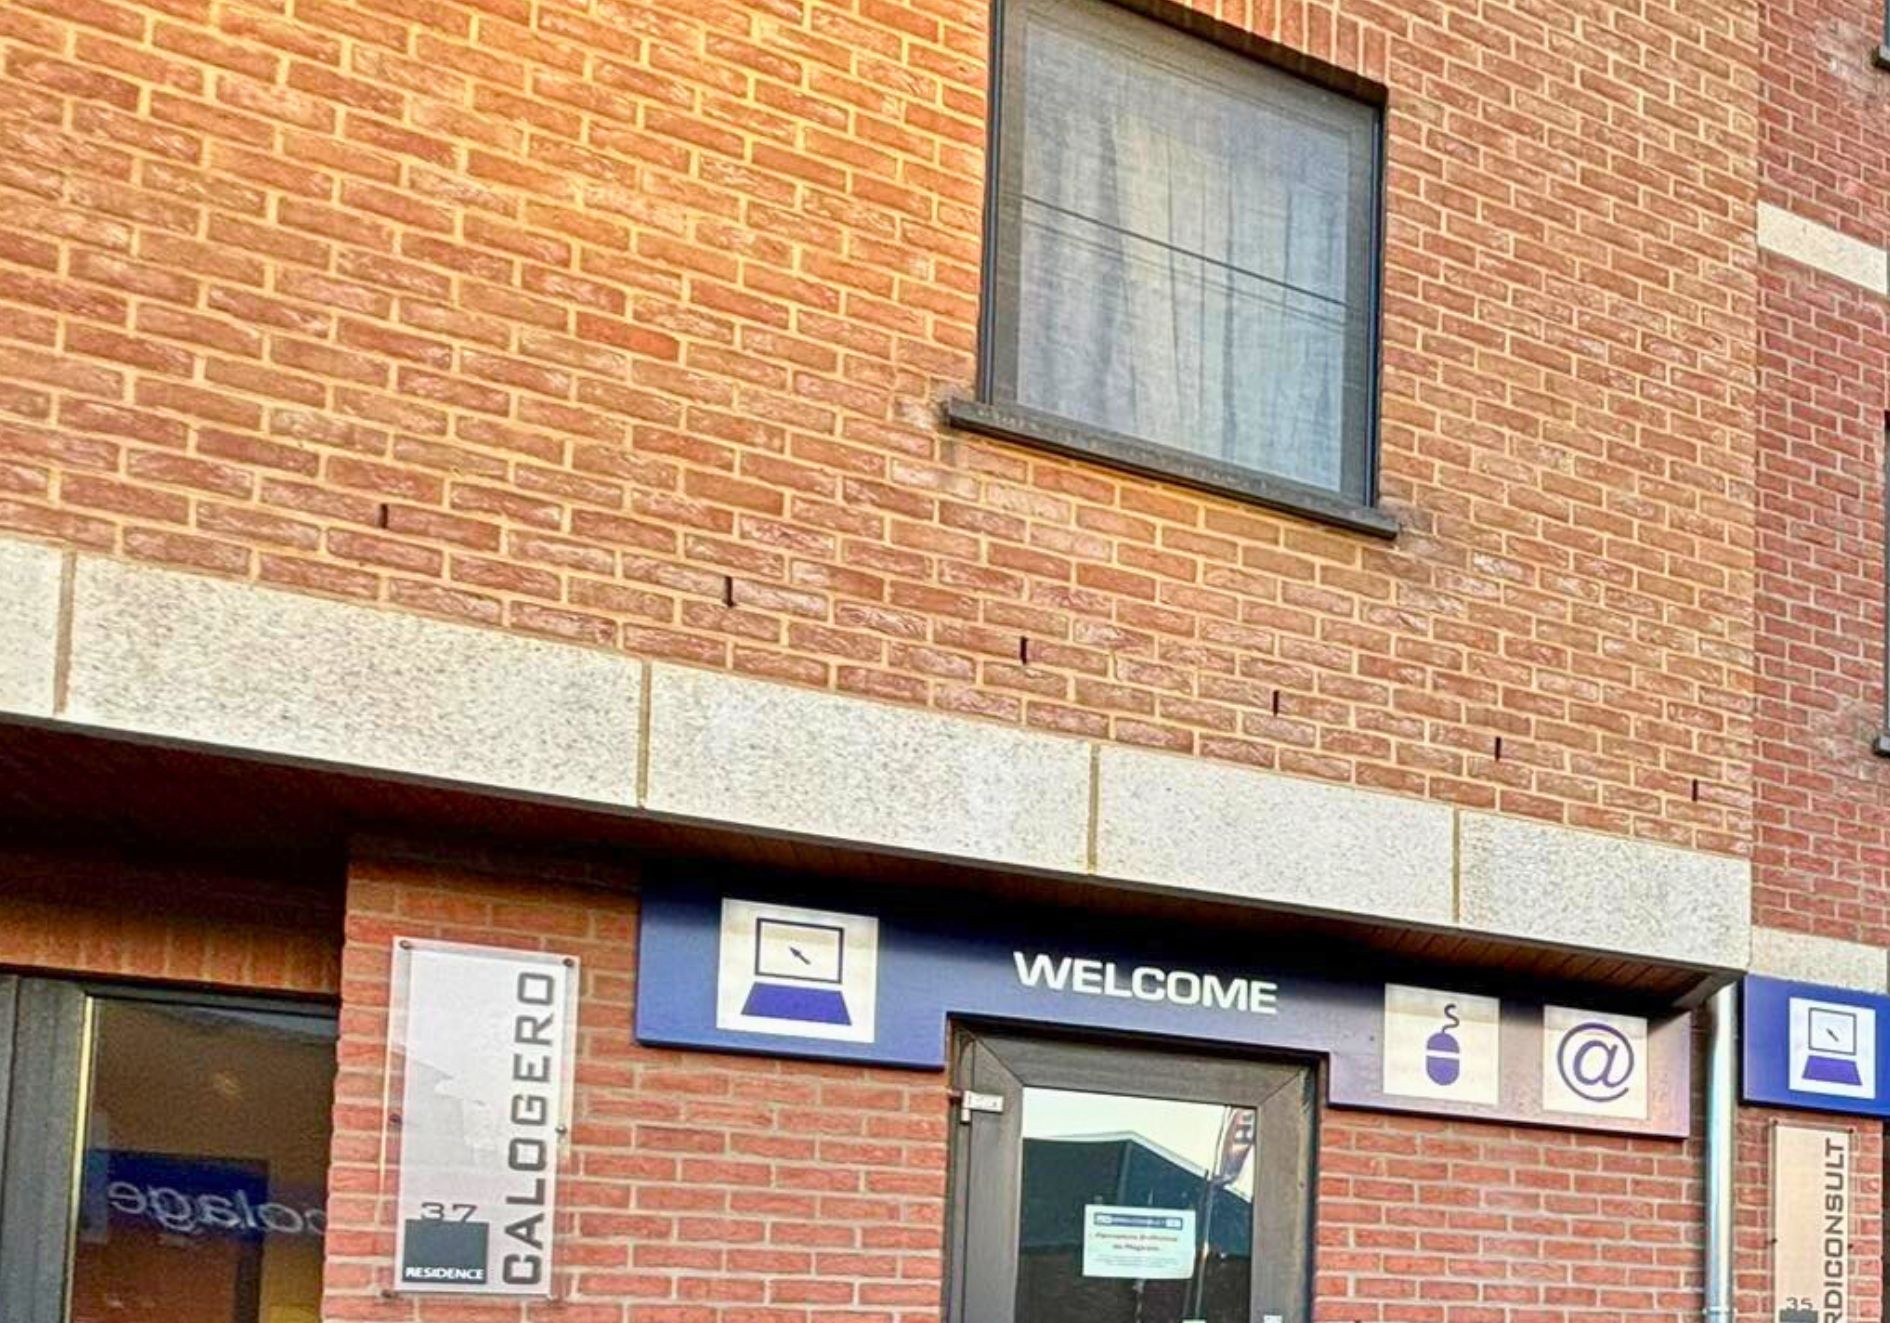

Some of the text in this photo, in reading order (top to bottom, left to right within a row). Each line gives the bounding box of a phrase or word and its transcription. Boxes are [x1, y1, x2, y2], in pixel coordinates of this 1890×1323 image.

[1013, 951, 1278, 1015] WELCOME
[1557, 1022, 1635, 1102] @
[502, 971, 555, 1286] CALOGERO
[421, 1202, 477, 1223] 37
[405, 1266, 485, 1280] RESIDENCE
[1786, 1297, 1813, 1312] 35
